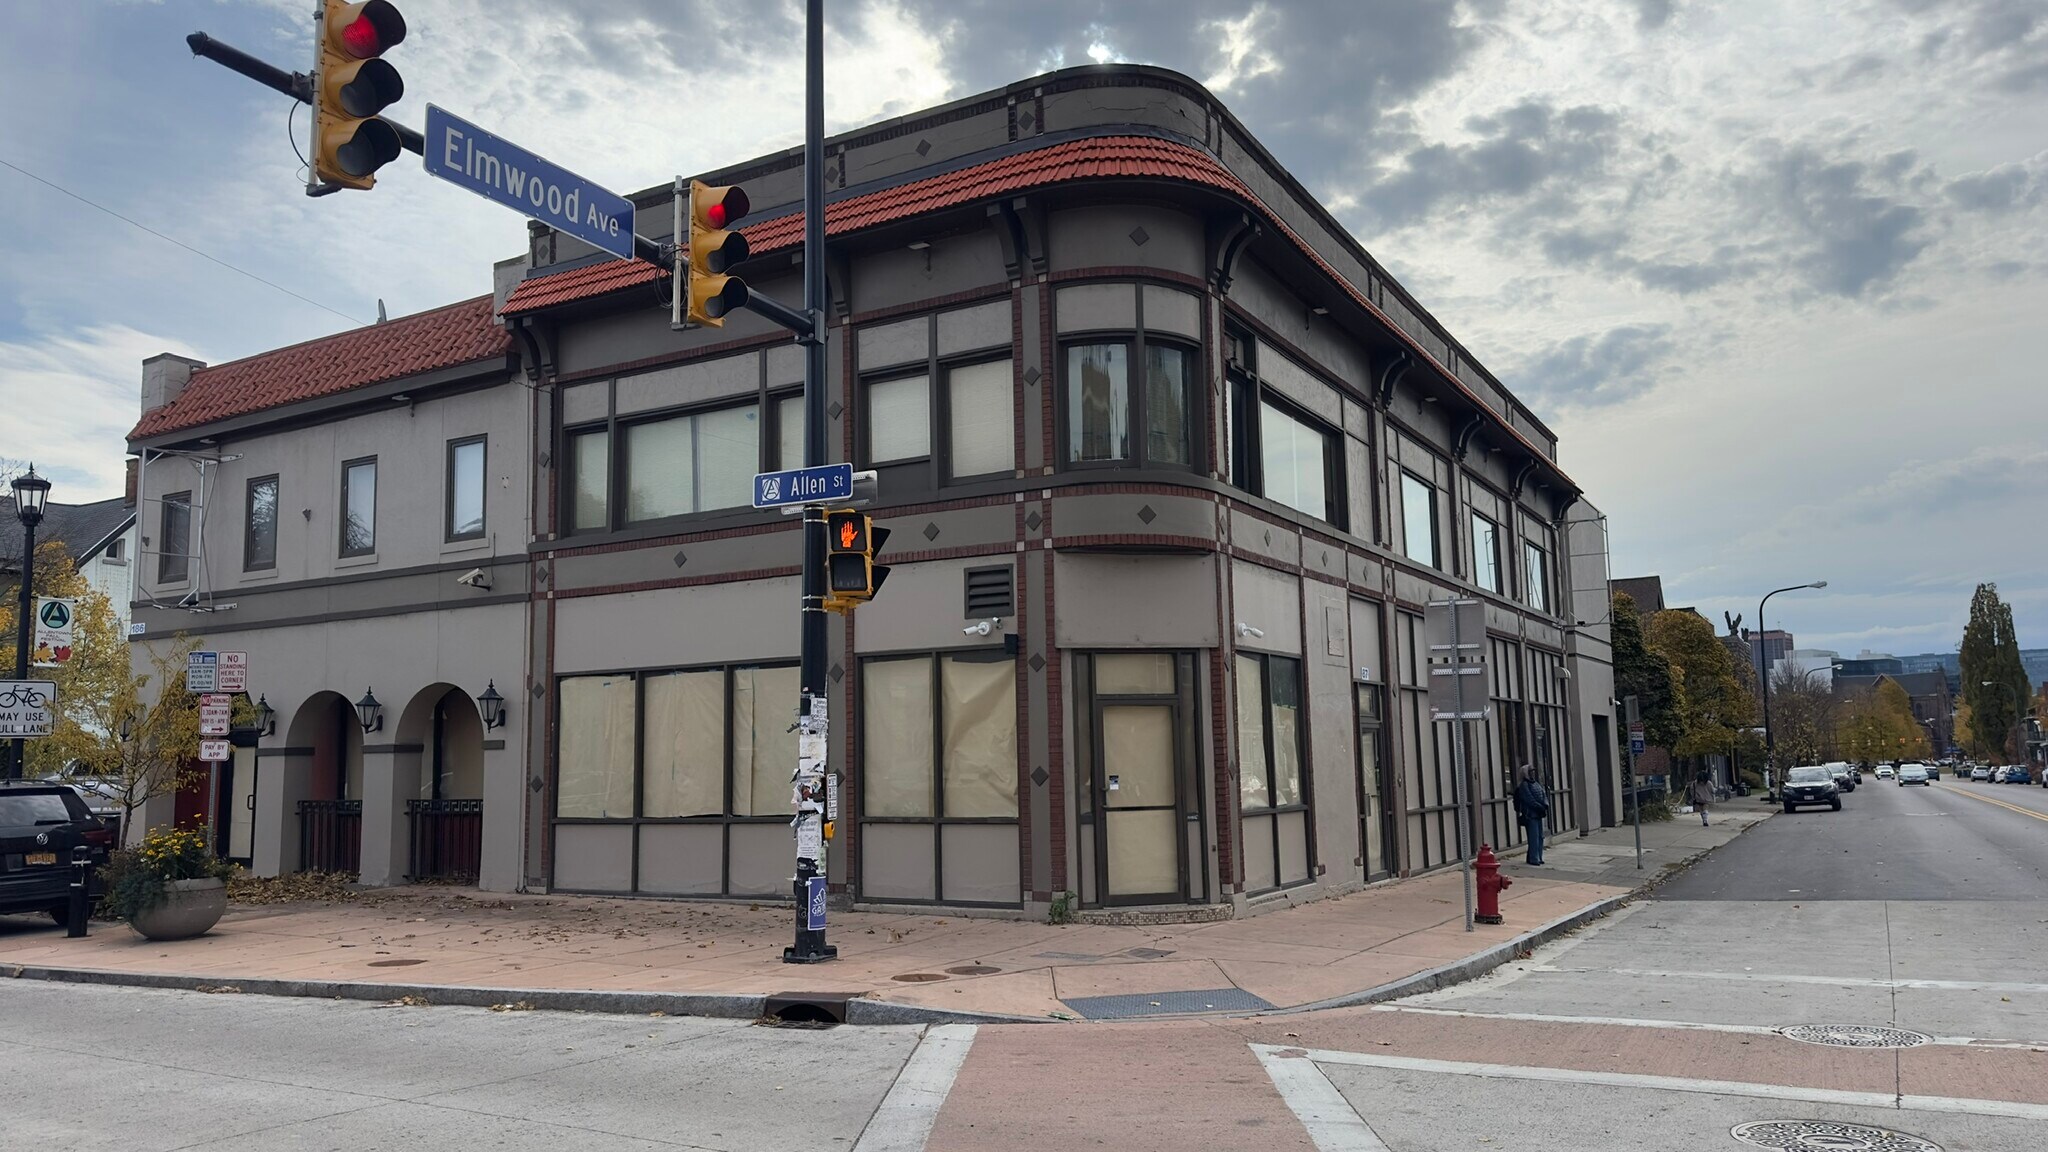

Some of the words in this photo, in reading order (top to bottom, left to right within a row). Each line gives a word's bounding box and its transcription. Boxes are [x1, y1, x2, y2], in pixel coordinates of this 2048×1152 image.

[445, 126, 580, 224] Elmwood
[586, 203, 619, 237] Ave
[790, 475, 826, 497] Allen
[833, 475, 844, 488] St
[131, 623, 145, 633] 186
[227, 655, 239, 663] NO
[202, 695, 211, 704] NO
[0, 712, 19, 721] MAY
[25, 712, 44, 721] USE
